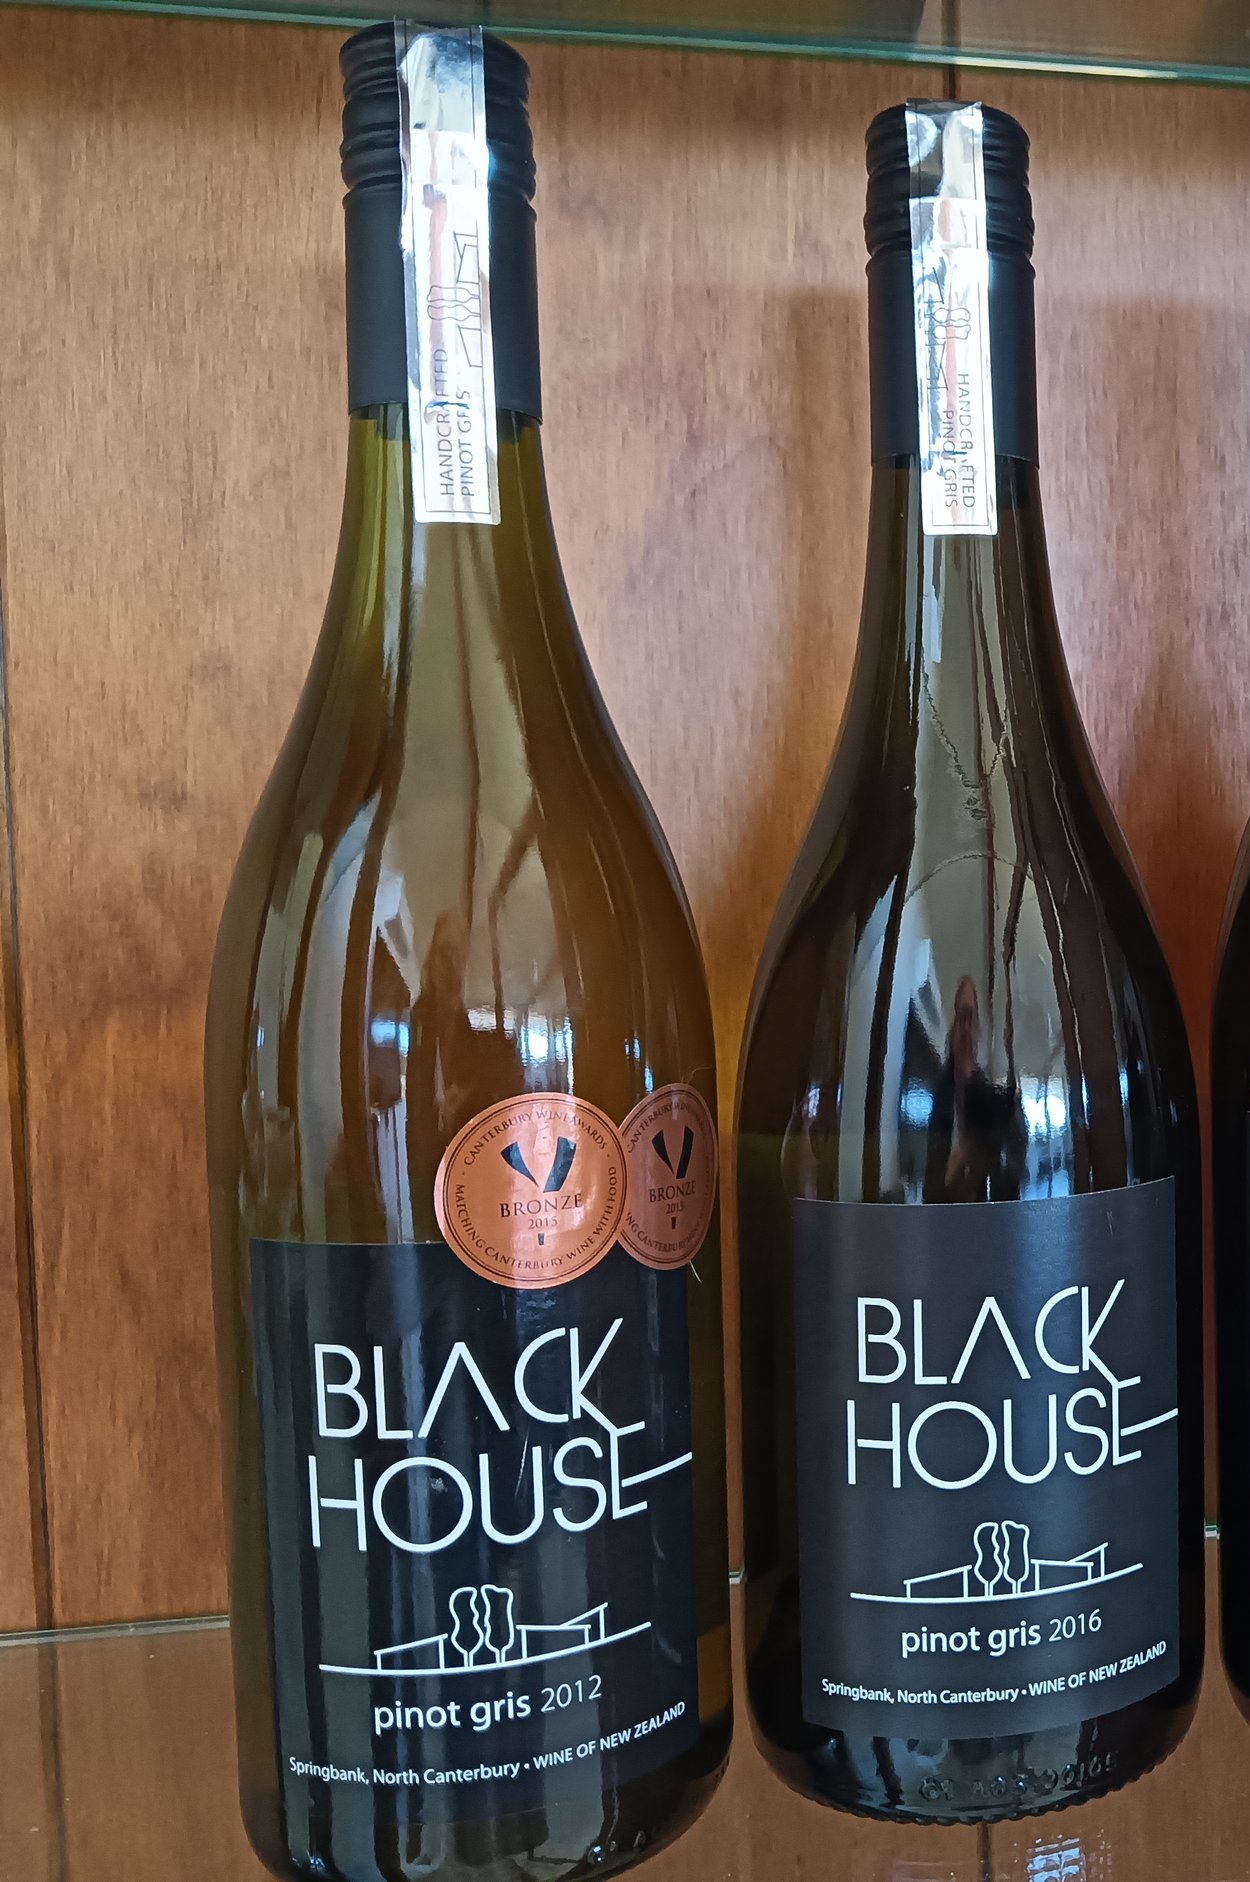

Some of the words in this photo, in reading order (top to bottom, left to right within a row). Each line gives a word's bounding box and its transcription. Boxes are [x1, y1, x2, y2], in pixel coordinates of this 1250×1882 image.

[433, 348, 455, 496] HANDCRFTED
[455, 390, 472, 433] GRS
[457, 438, 475, 497] PINOT
[944, 468, 959, 508] GRIS
[464, 1112, 533, 1166] CANTERBURY
[569, 1115, 607, 1149] AWARDS
[455, 1183, 486, 1249] MATCHING
[485, 1246, 564, 1271] CANTERBURY
[566, 1237, 596, 1261] WINE
[593, 1205, 614, 1239] WITH
[608, 1166, 618, 1203] FOOD
[500, 1193, 583, 1218] BRONZE
[528, 1216, 558, 1230] 2015
[649, 1181, 697, 1203] BRONZE
[857, 1279, 1126, 1385] BLACK
[314, 1317, 624, 1440] BLACK
[846, 1375, 1179, 1490] HOUSE
[307, 1421, 693, 1554] HOUSE
[901, 1626, 981, 1659] pinot
[988, 1620, 1042, 1657] gris
[1048, 1608, 1102, 1642] 2016
[821, 1678, 895, 1704] Springbank,
[897, 1689, 938, 1704] North
[940, 1687, 1019, 1704] Canterbury
[1028, 1676, 1066, 1697] WINE
[1067, 1671, 1087, 1689] OF
[1089, 1662, 1118, 1683] NEW
[1119, 1640, 1167, 1674] ZEALAND
[374, 1700, 461, 1736] pinot
[469, 1691, 532, 1731] gris
[540, 1674, 602, 1713] 2012
[289, 1756, 370, 1785] Springbank,
[373, 1768, 420, 1785] North
[423, 1762, 520, 1785] Canterbury
[533, 1747, 573, 1770] WINE
[576, 1740, 596, 1758] OF
[600, 1728, 631, 1751] NEW
[633, 1701, 686, 1739] ZEALAND
